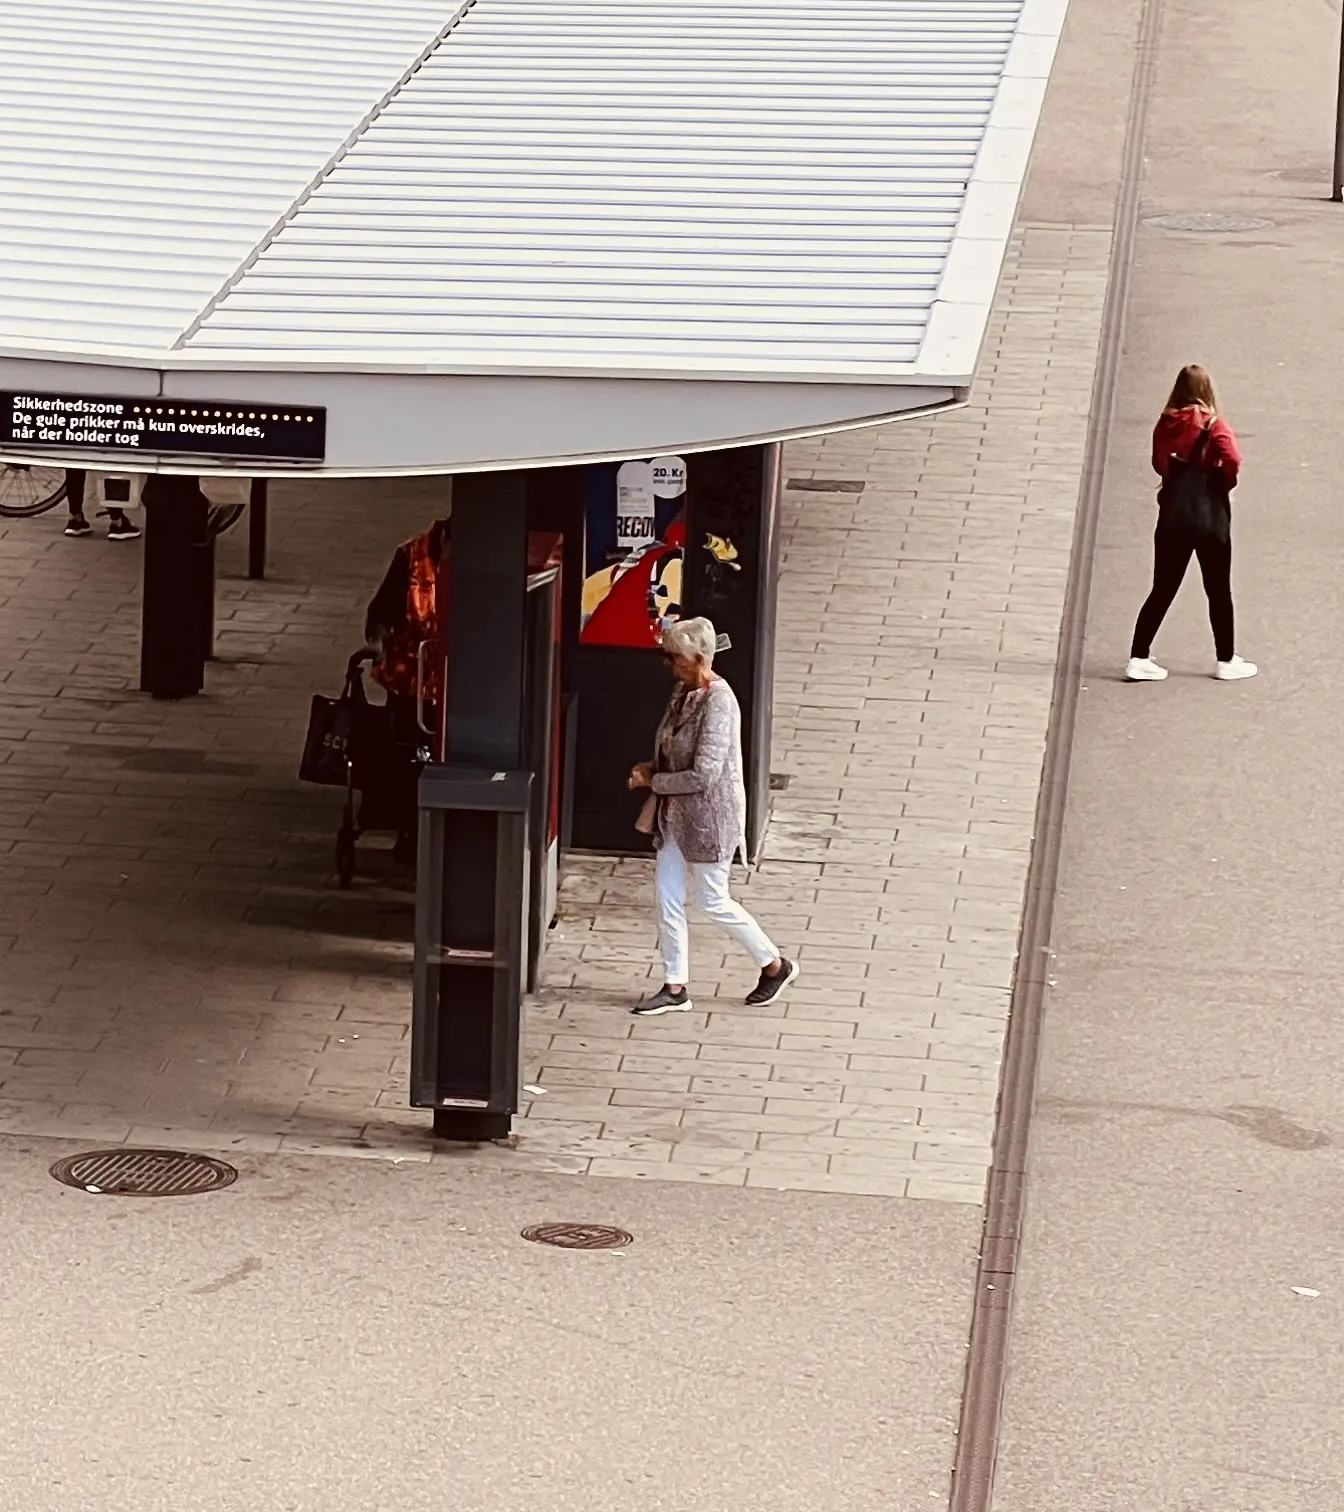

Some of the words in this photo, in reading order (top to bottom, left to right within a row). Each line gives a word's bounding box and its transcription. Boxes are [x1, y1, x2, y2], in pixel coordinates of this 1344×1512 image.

[13, 396, 124, 415] Sikkerhedszone
[12, 425, 36, 439] når
[38, 428, 63, 441] der
[65, 428, 113, 444] holder
[114, 433, 140, 447] tog
[13, 411, 32, 425] De
[35, 414, 67, 428] gule
[69, 415, 121, 430] prikker
[123, 417, 145, 431] må
[149, 418, 176, 432] kun
[179, 422, 265, 439] overskrides,
